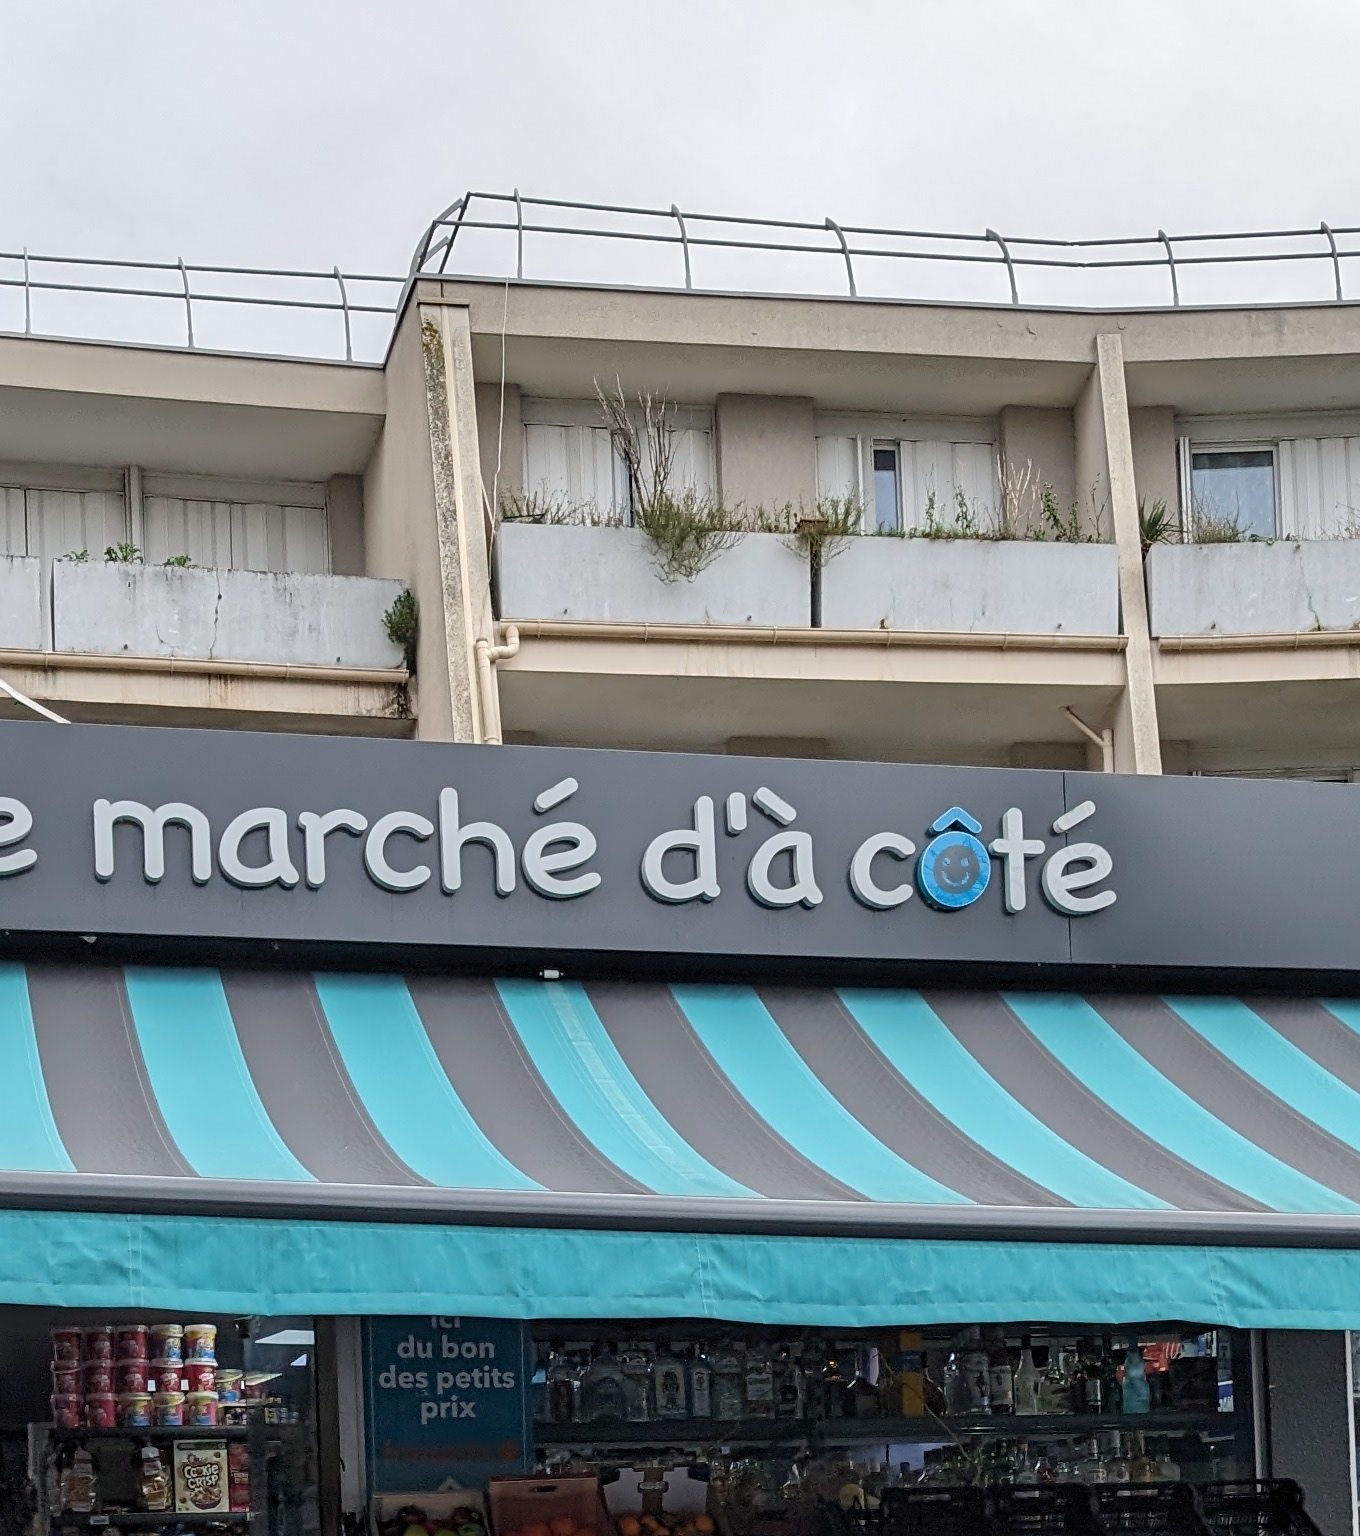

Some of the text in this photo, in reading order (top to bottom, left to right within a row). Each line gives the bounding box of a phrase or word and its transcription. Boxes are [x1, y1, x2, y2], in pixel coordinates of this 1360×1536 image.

[92, 777, 602, 898] marché
[641, 786, 823, 908] d'à
[850, 800, 1117, 915] côté
[397, 1335, 495, 1358] du bon
[378, 1364, 515, 1395] des petits
[420, 1395, 476, 1425] prix
